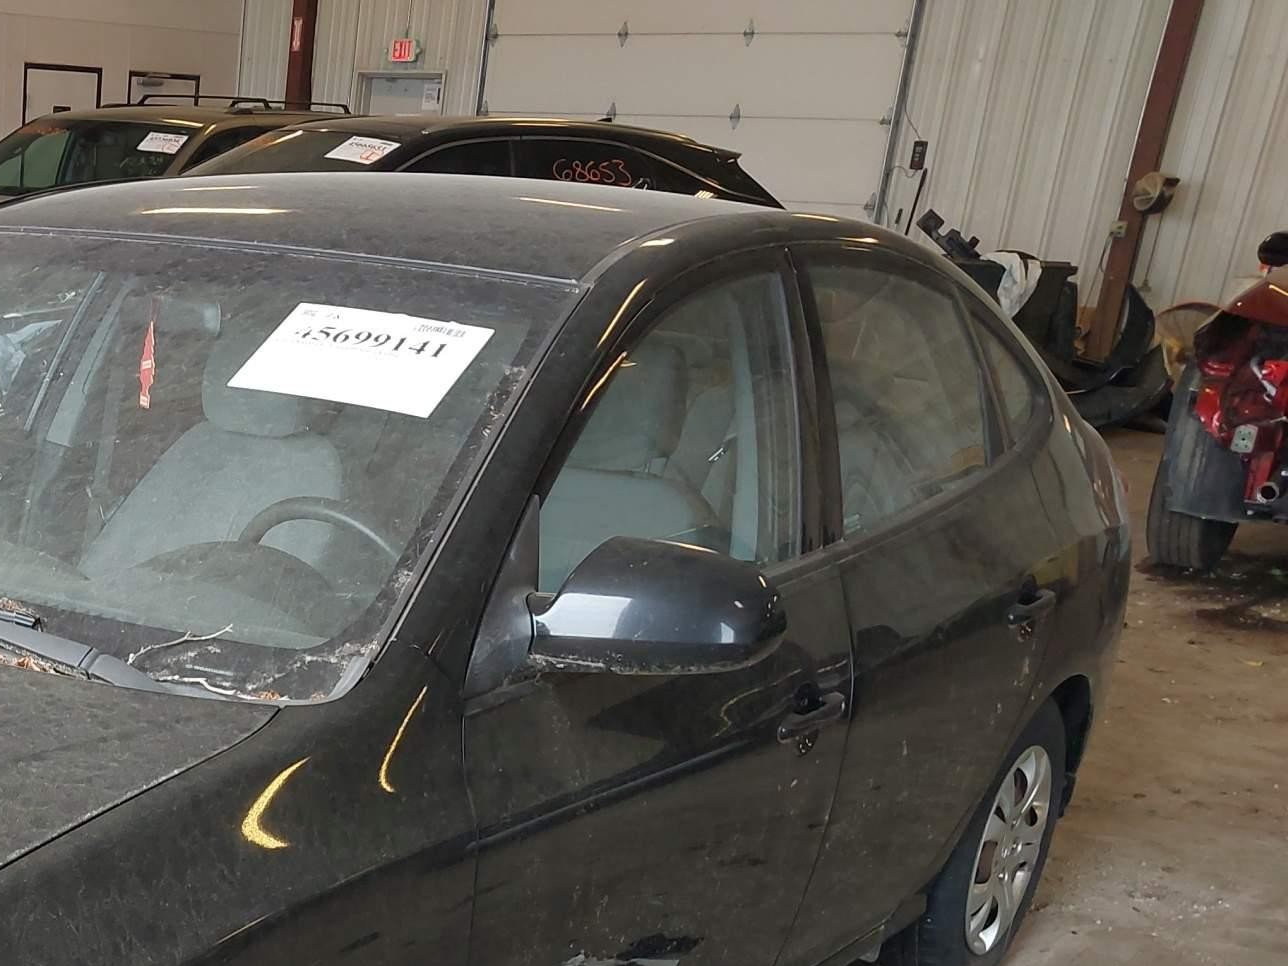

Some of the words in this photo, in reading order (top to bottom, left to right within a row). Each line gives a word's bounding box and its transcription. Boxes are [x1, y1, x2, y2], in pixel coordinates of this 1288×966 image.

[393, 40, 413, 58] EXIT
[553, 159, 632, 186] 68653
[295, 325, 447, 357] 45699141
